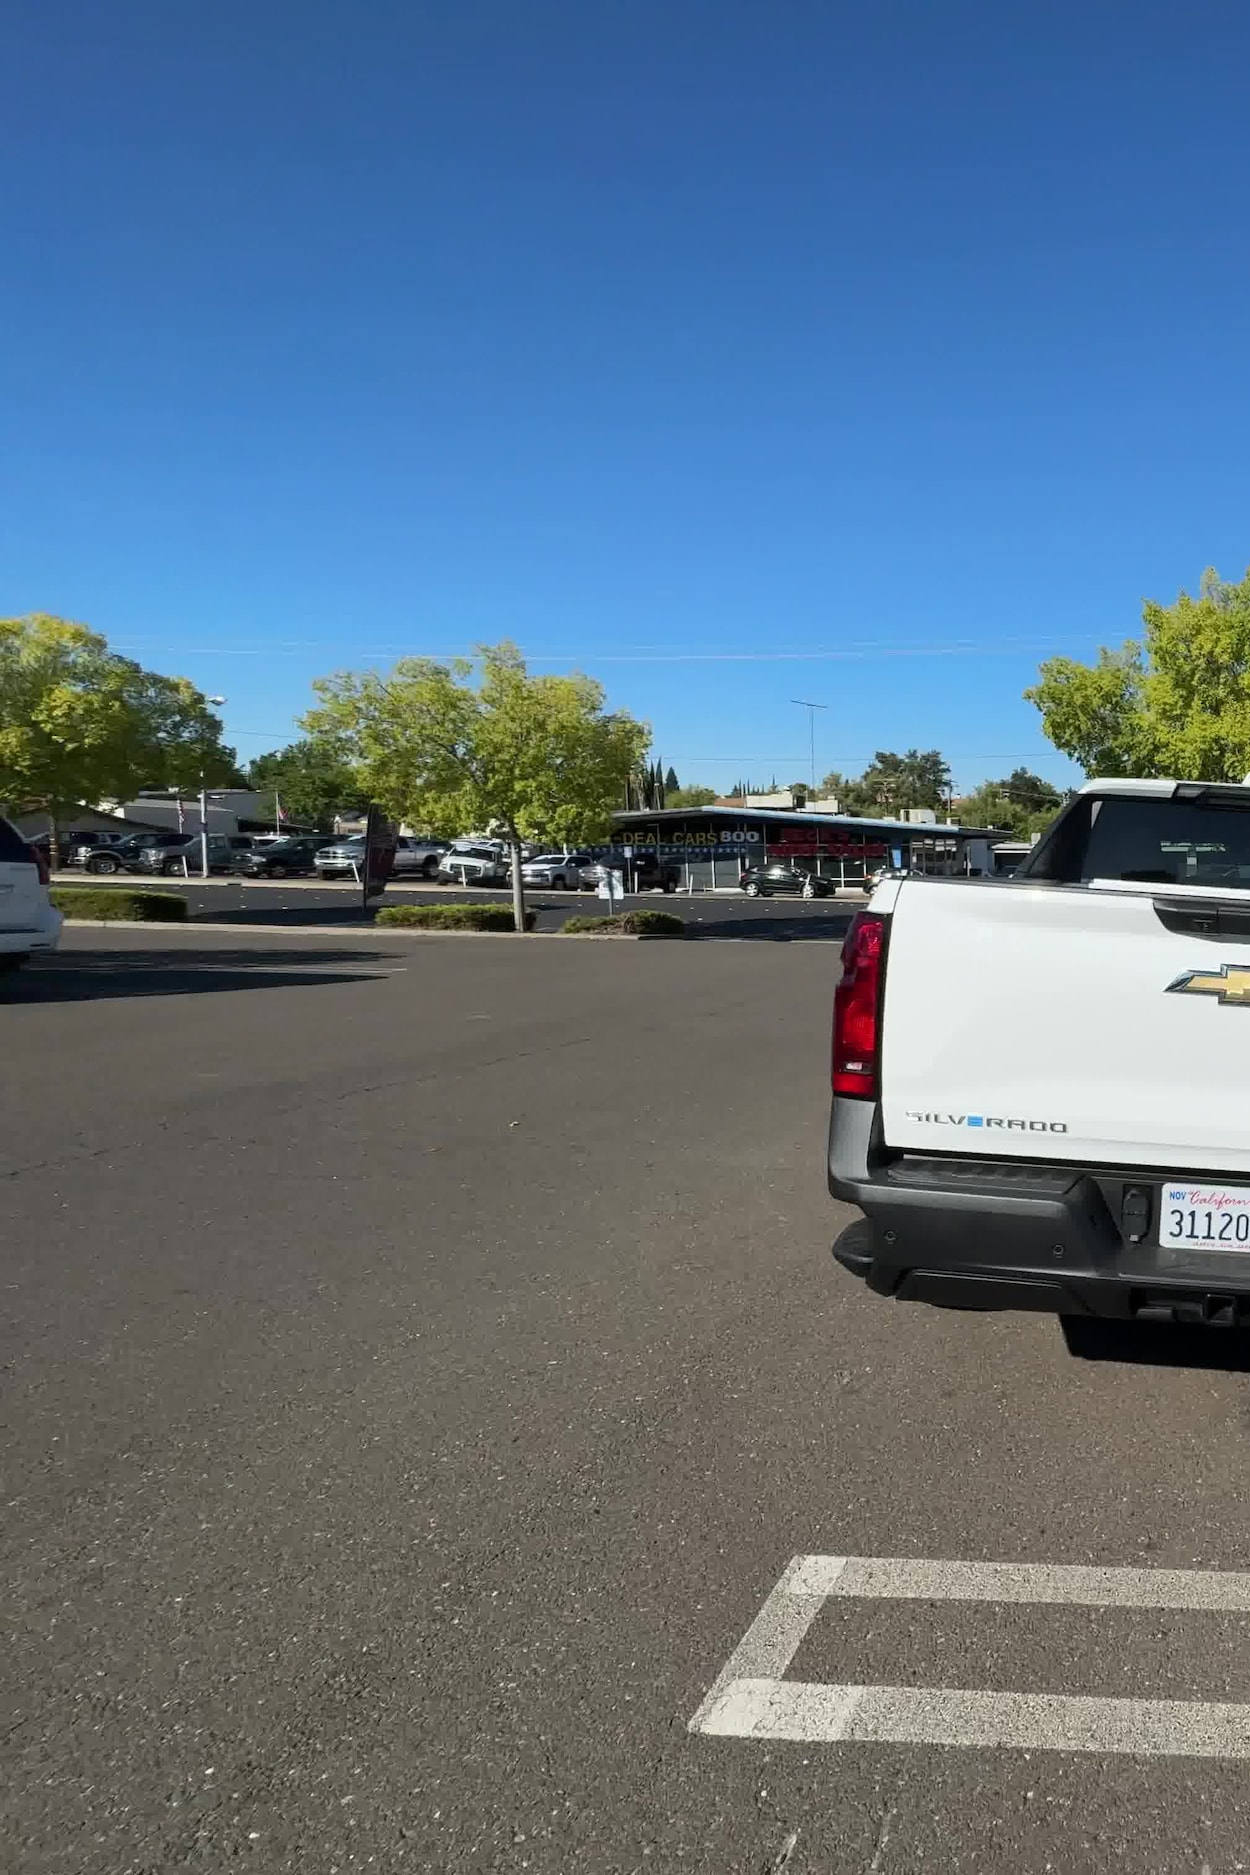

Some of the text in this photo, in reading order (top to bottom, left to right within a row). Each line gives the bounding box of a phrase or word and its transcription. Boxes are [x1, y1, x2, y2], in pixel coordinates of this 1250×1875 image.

[672, 832, 718, 844] CARS
[720, 831, 760, 842] 800
[905, 1110, 1067, 1133] SILVERADO
[1169, 1191, 1187, 1200] NOV
